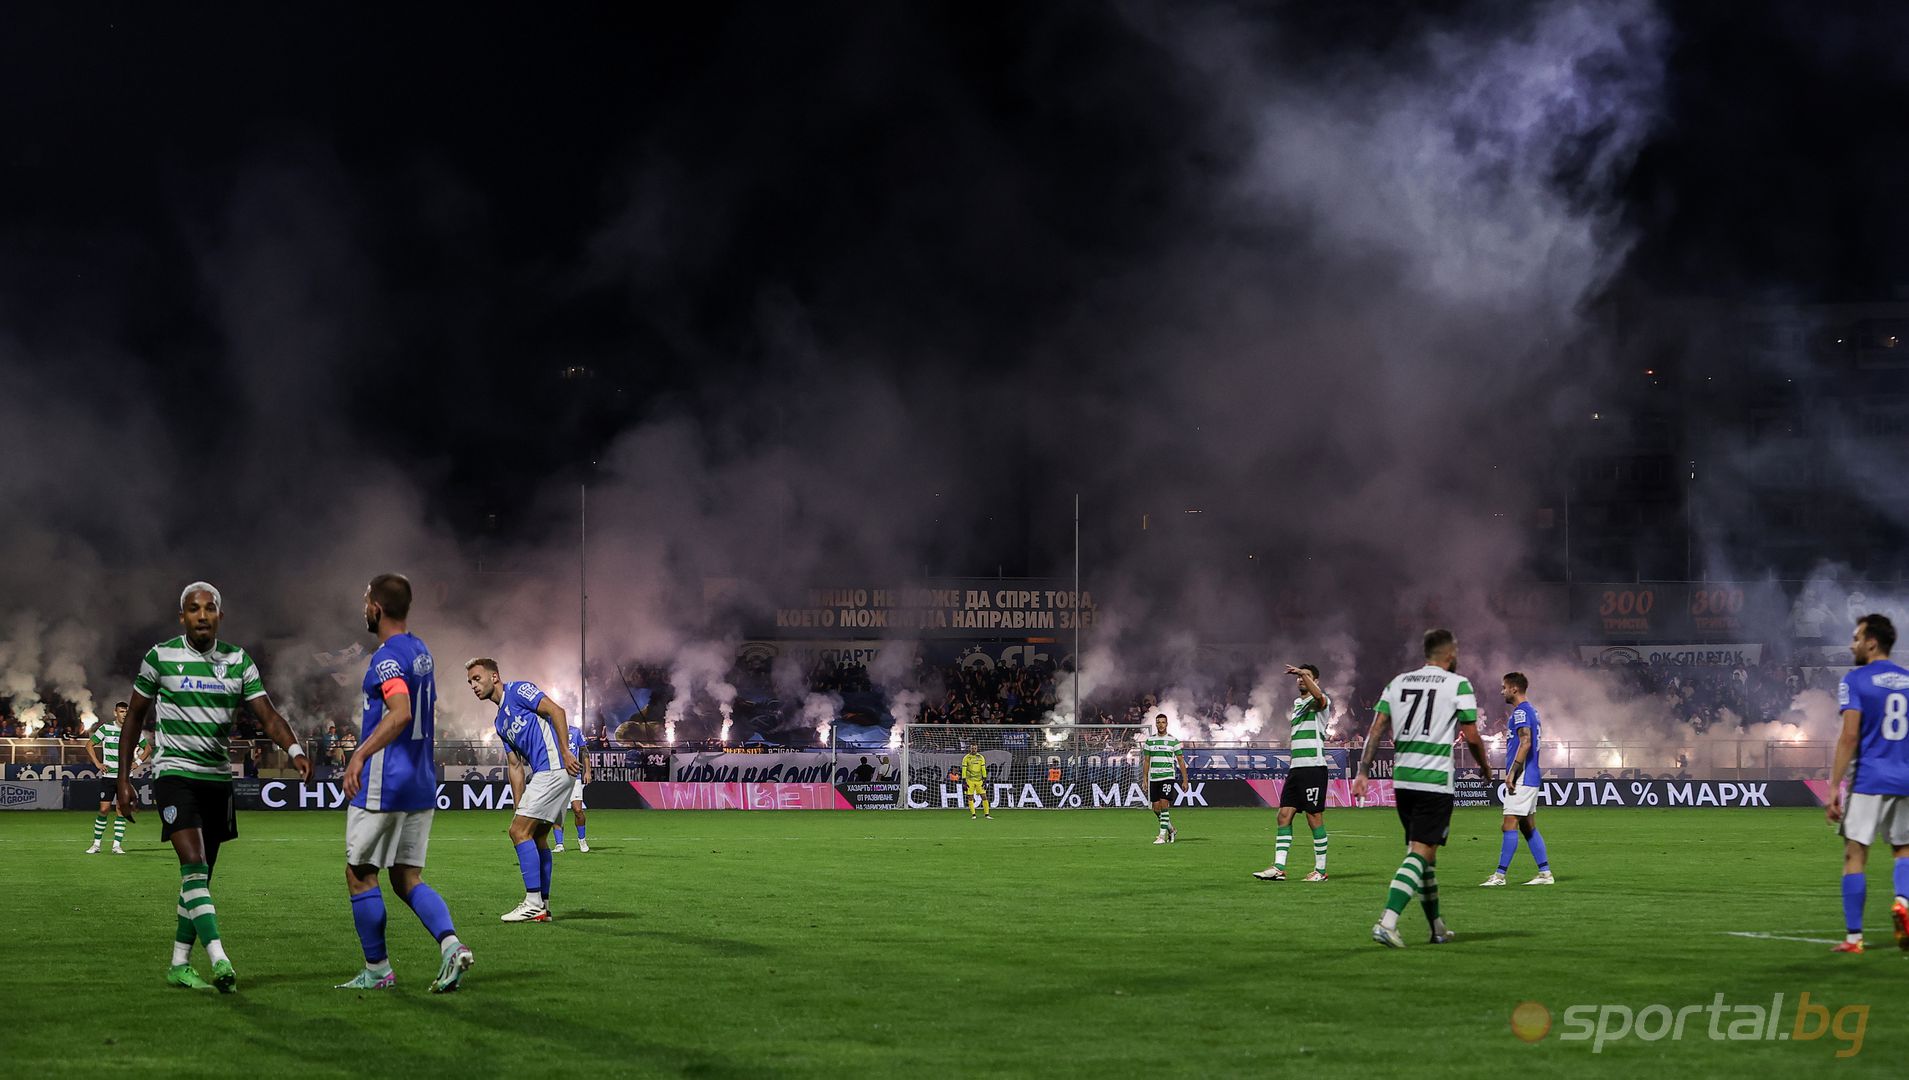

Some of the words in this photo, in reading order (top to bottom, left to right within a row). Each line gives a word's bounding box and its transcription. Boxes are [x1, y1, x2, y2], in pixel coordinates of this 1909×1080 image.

[965, 590, 991, 609] ДА
[995, 590, 1039, 608] СПРЕ
[1600, 591, 1654, 616] 300
[1692, 591, 1744, 616] 300
[777, 609, 835, 627] КОЕТО
[952, 610, 1055, 628] НАПРАВИМ
[1650, 652, 1672, 665] ФК
[1675, 651, 1743, 665] СПАРТАК
[1400, 688, 1436, 735] 71
[1881, 692, 1908, 741] 8
[603, 753, 626, 767] NEW
[940, 782, 1043, 808] НЛА
[1051, 782, 1081, 808] %
[1091, 782, 1208, 807] МАЖ
[1162, 783, 1172, 792] 28
[1306, 787, 1319, 801] 27
[1630, 782, 1659, 806] %
[1667, 782, 1769, 806] МАРЖ
